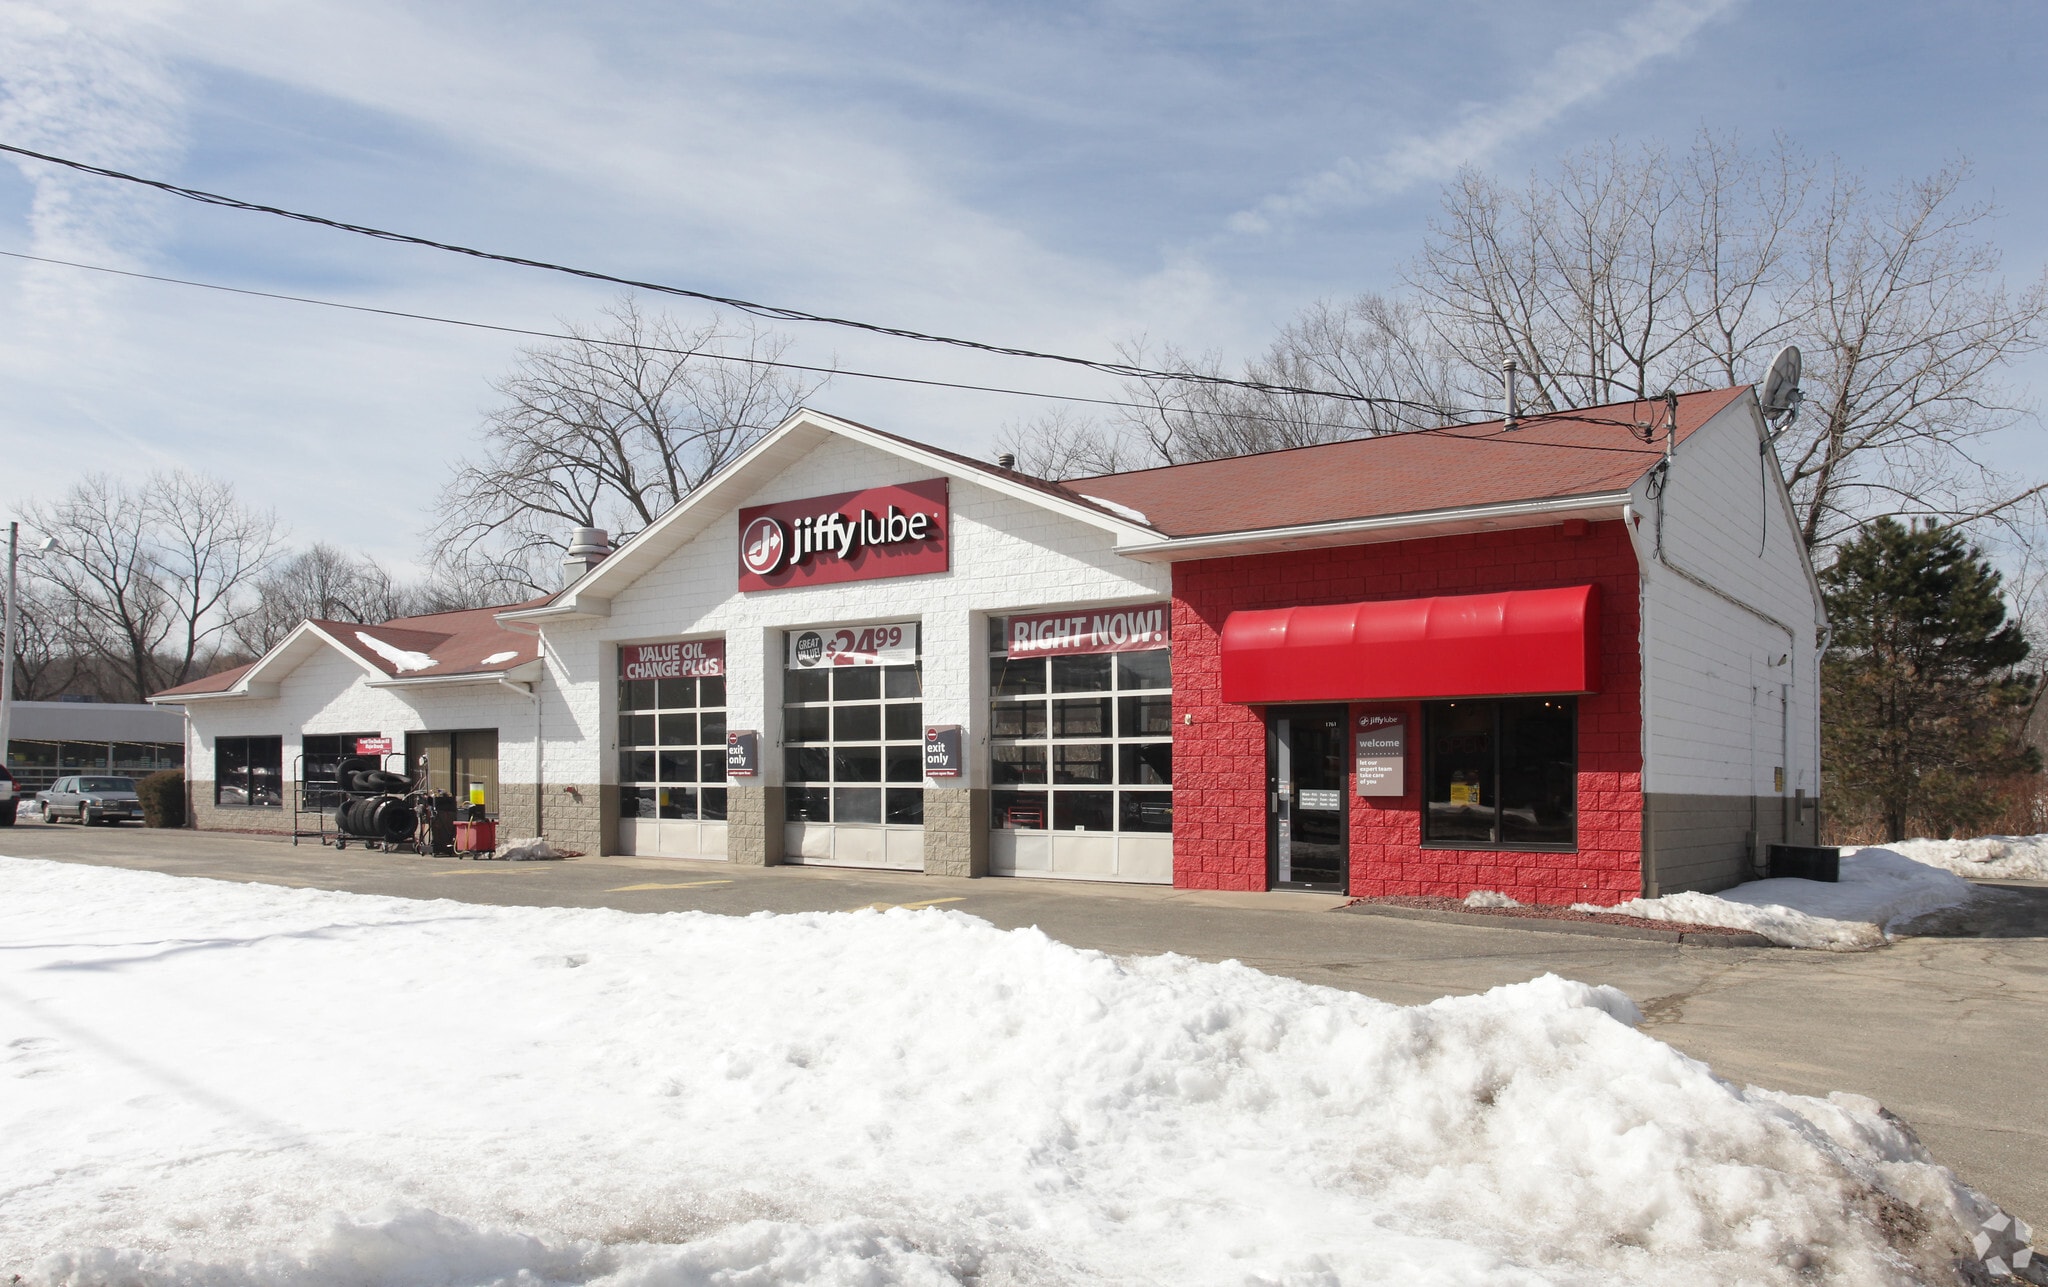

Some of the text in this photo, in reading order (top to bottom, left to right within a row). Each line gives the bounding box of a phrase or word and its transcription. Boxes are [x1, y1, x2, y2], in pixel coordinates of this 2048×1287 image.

[789, 511, 856, 565] jiffy
[860, 505, 927, 545] lube
[1013, 609, 1162, 652] RIGHT NOW!
[798, 637, 820, 650] GREAT
[638, 643, 706, 662] VALUE OIL
[797, 647, 820, 661] VALUE!
[626, 658, 719, 679] CHANGE PLUS
[1369, 715, 1398, 725] jiffy lube
[729, 745, 744, 754] exit
[927, 742, 945, 752] exit
[1360, 739, 1399, 747] welcome
[729, 755, 746, 766] only
[927, 753, 948, 766] only
